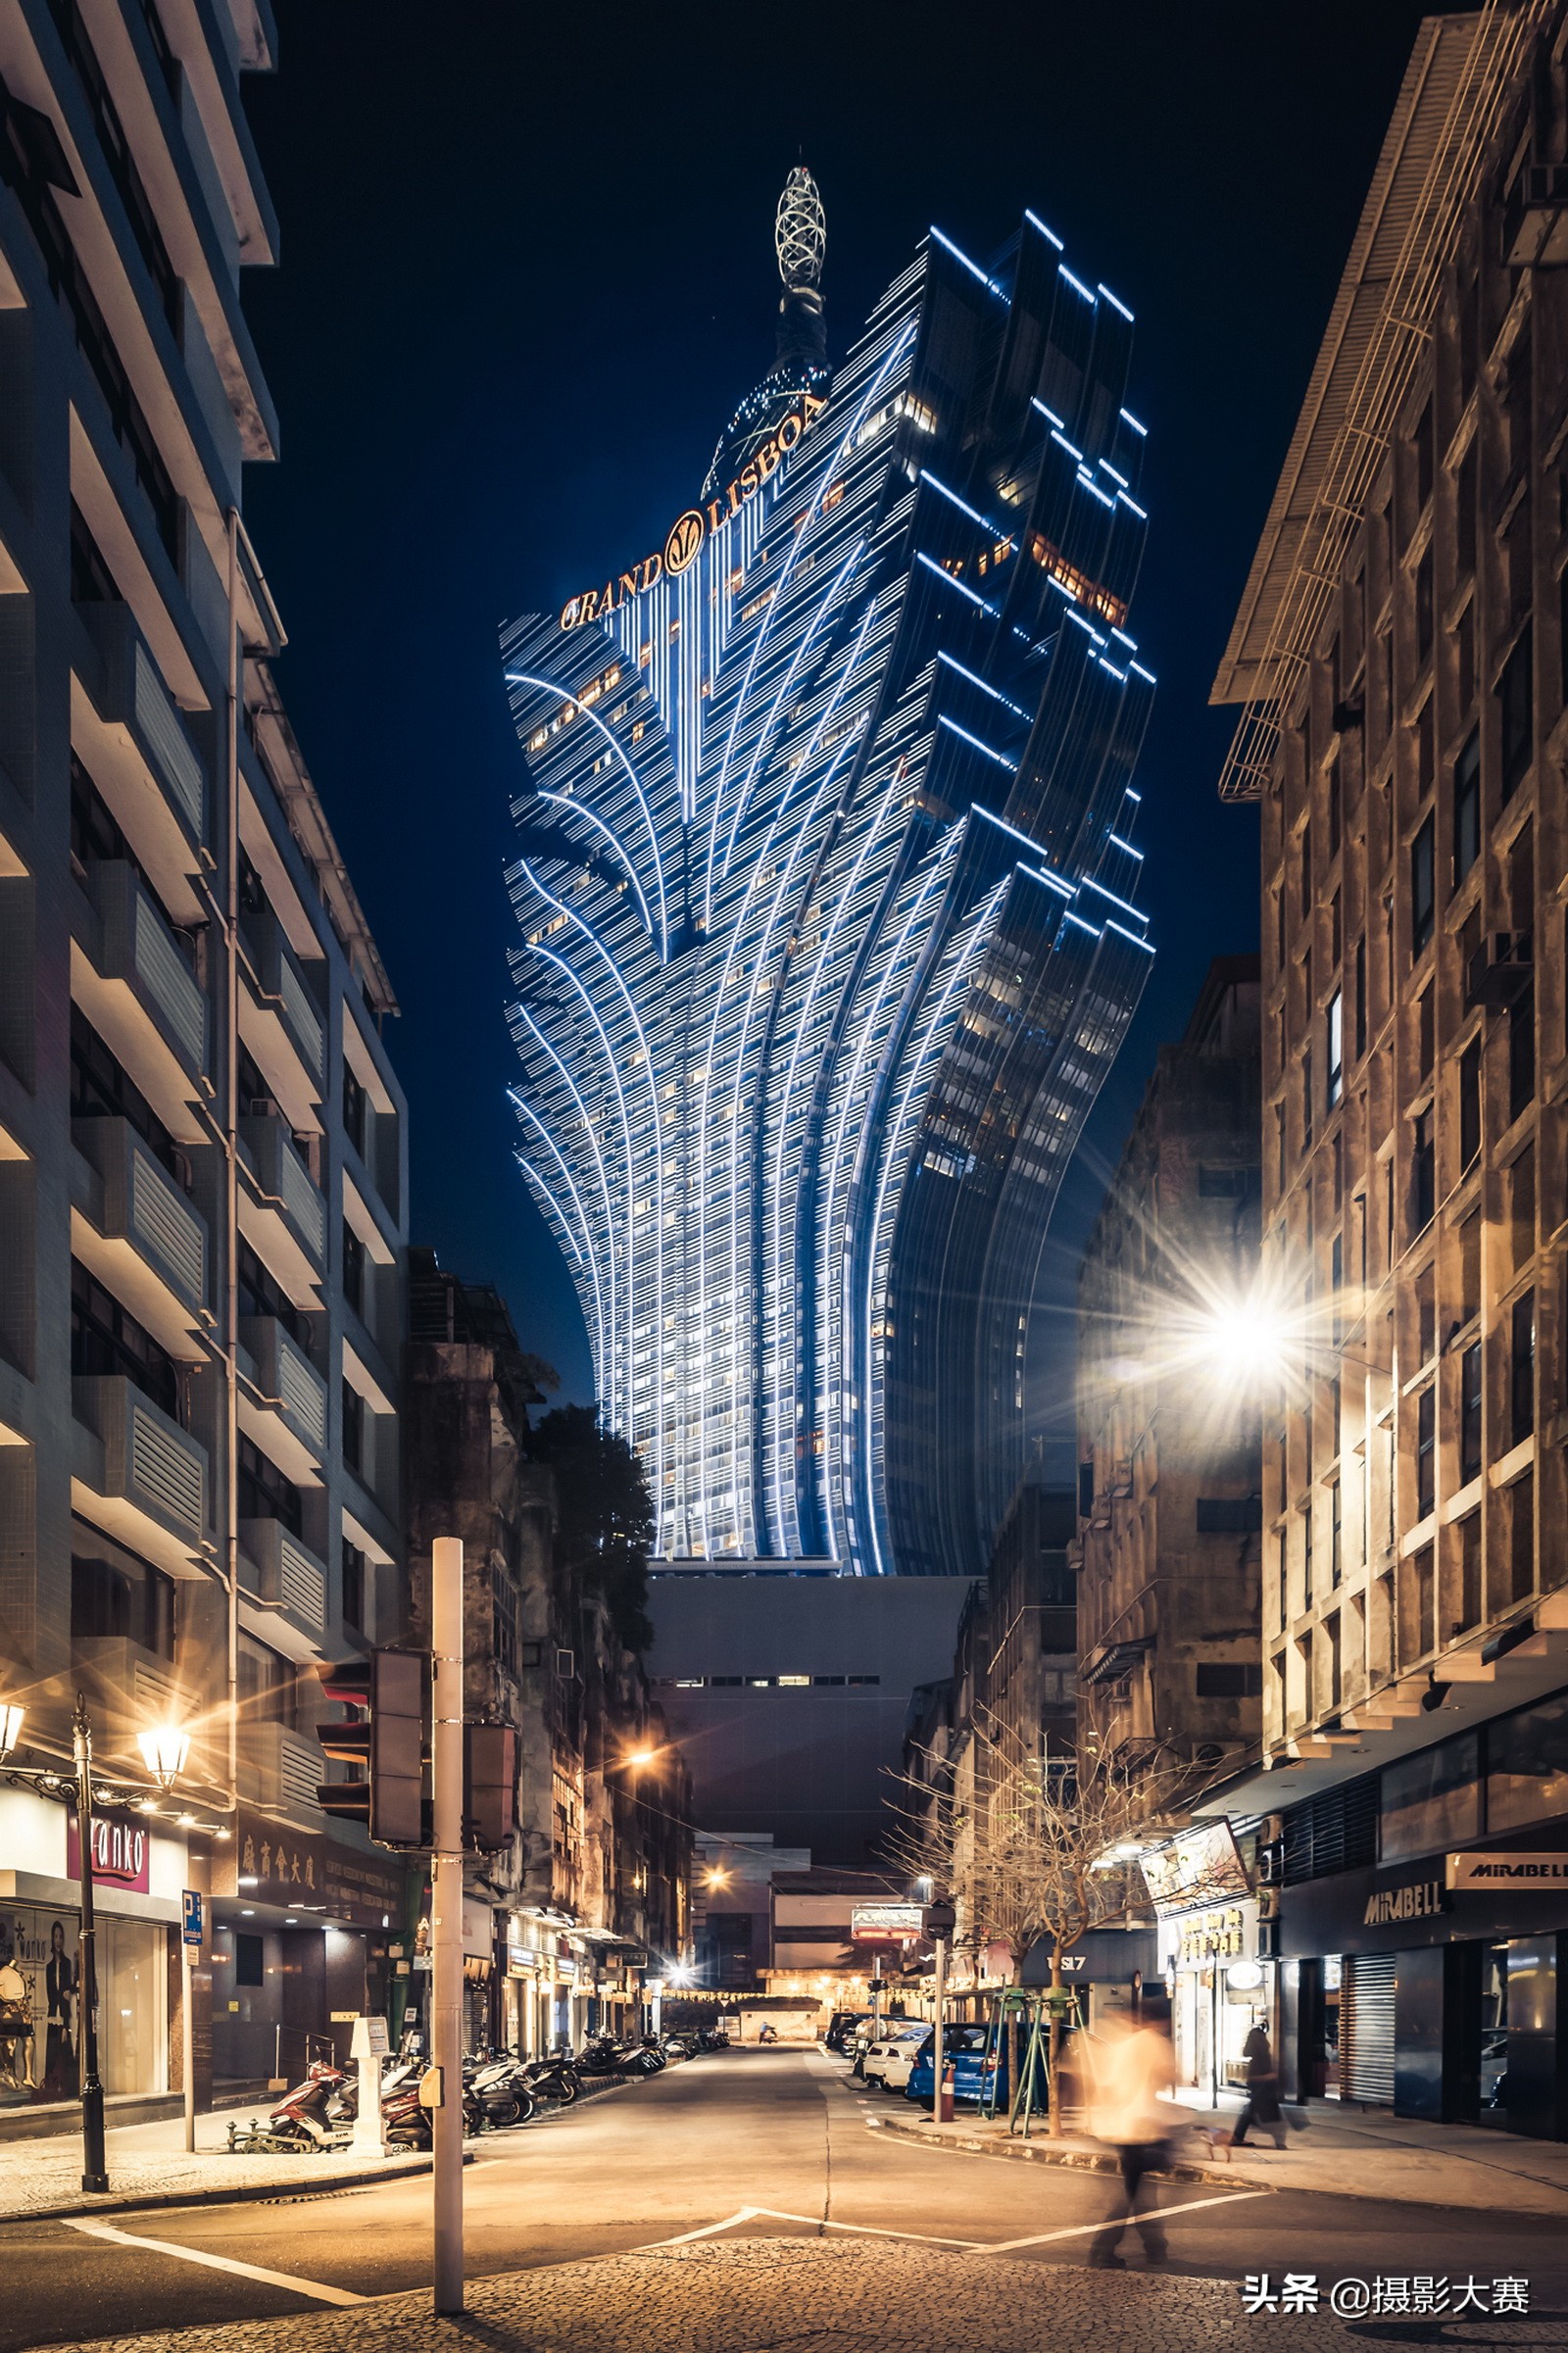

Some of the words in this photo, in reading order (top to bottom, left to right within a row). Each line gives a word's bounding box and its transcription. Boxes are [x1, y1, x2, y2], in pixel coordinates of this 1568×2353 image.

[559, 553, 663, 631] GRAND
[707, 393, 830, 538] LISBOA
[183, 1893, 194, 1929] P
